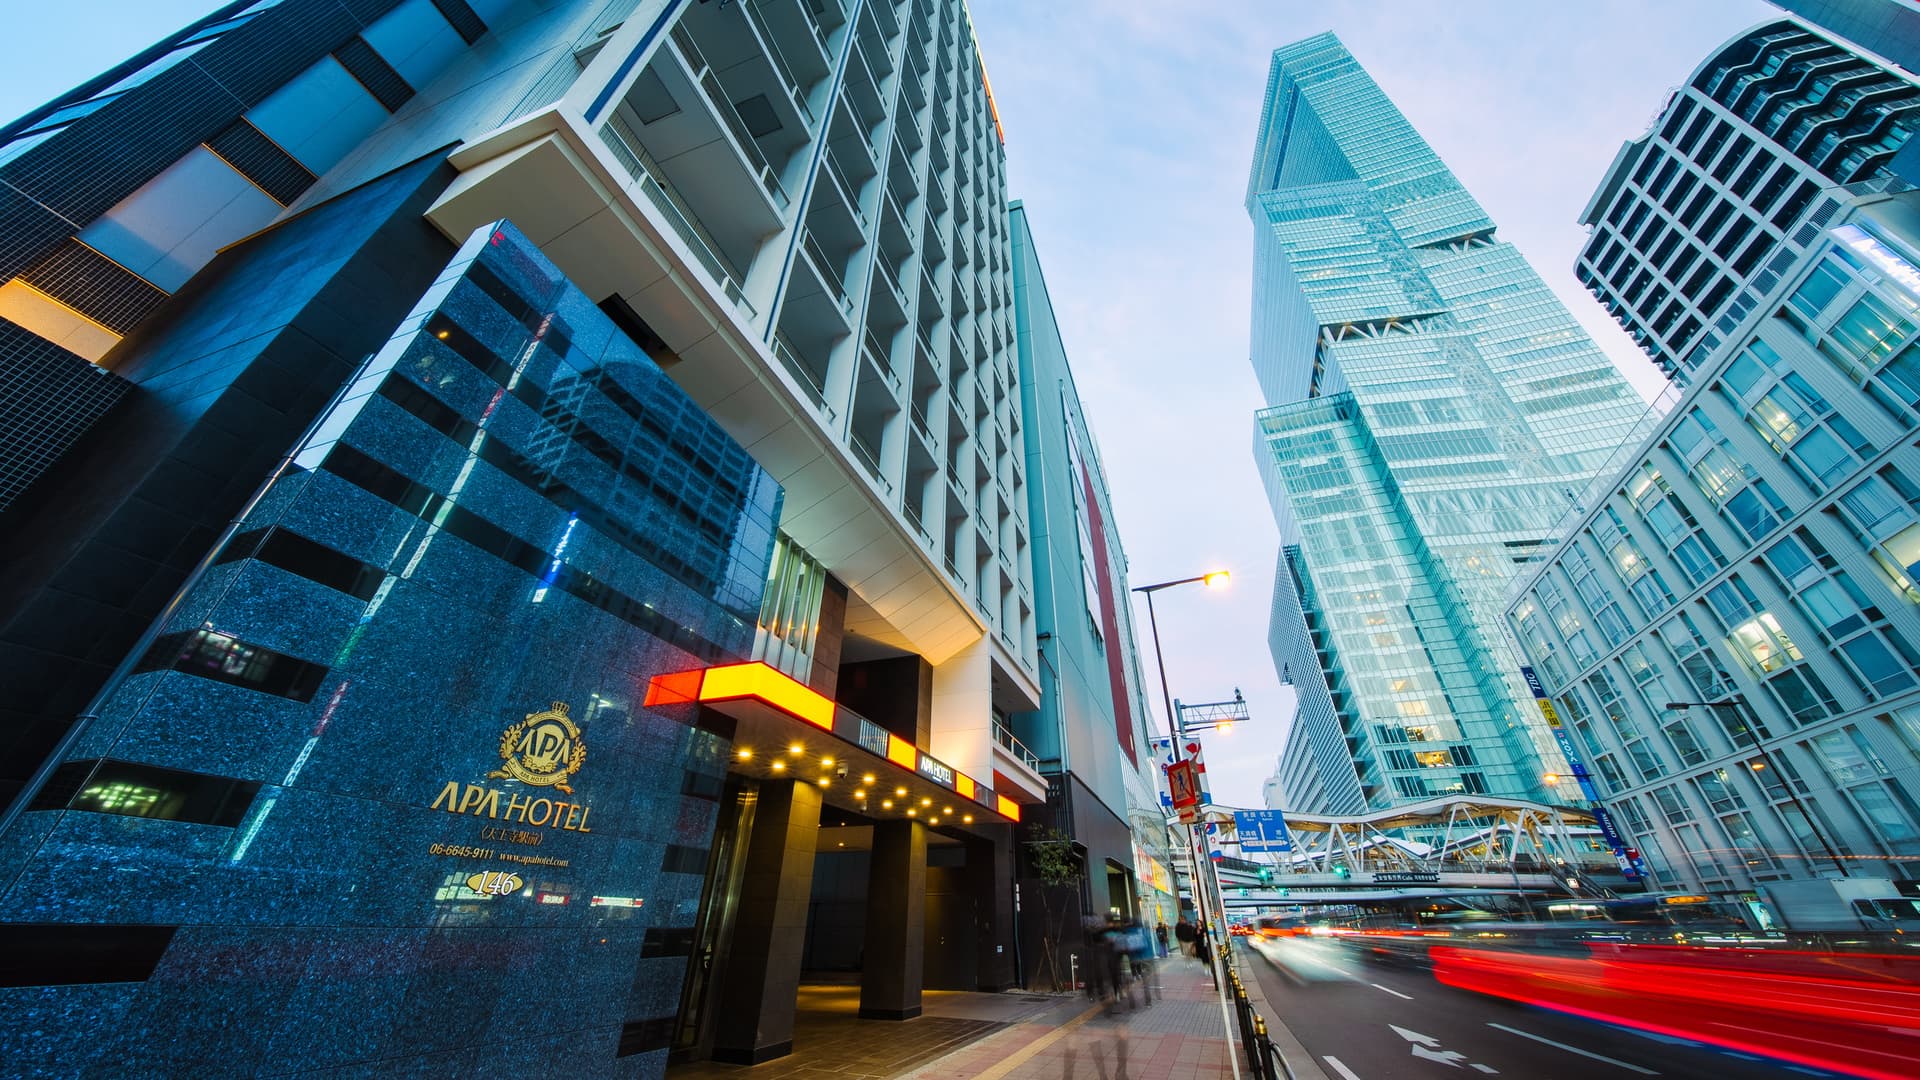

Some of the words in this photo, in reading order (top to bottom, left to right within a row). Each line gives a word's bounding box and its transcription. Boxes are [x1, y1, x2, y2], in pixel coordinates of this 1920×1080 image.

[516, 729, 570, 764] APA
[921, 756, 934, 775] APA
[933, 762, 952, 784] HOTEL
[430, 781, 500, 819] APA
[504, 793, 591, 833] HOTEL
[429, 843, 495, 860] 06-6645-9111
[499, 852, 569, 867] www.apahotel.com
[475, 870, 518, 896] 146
